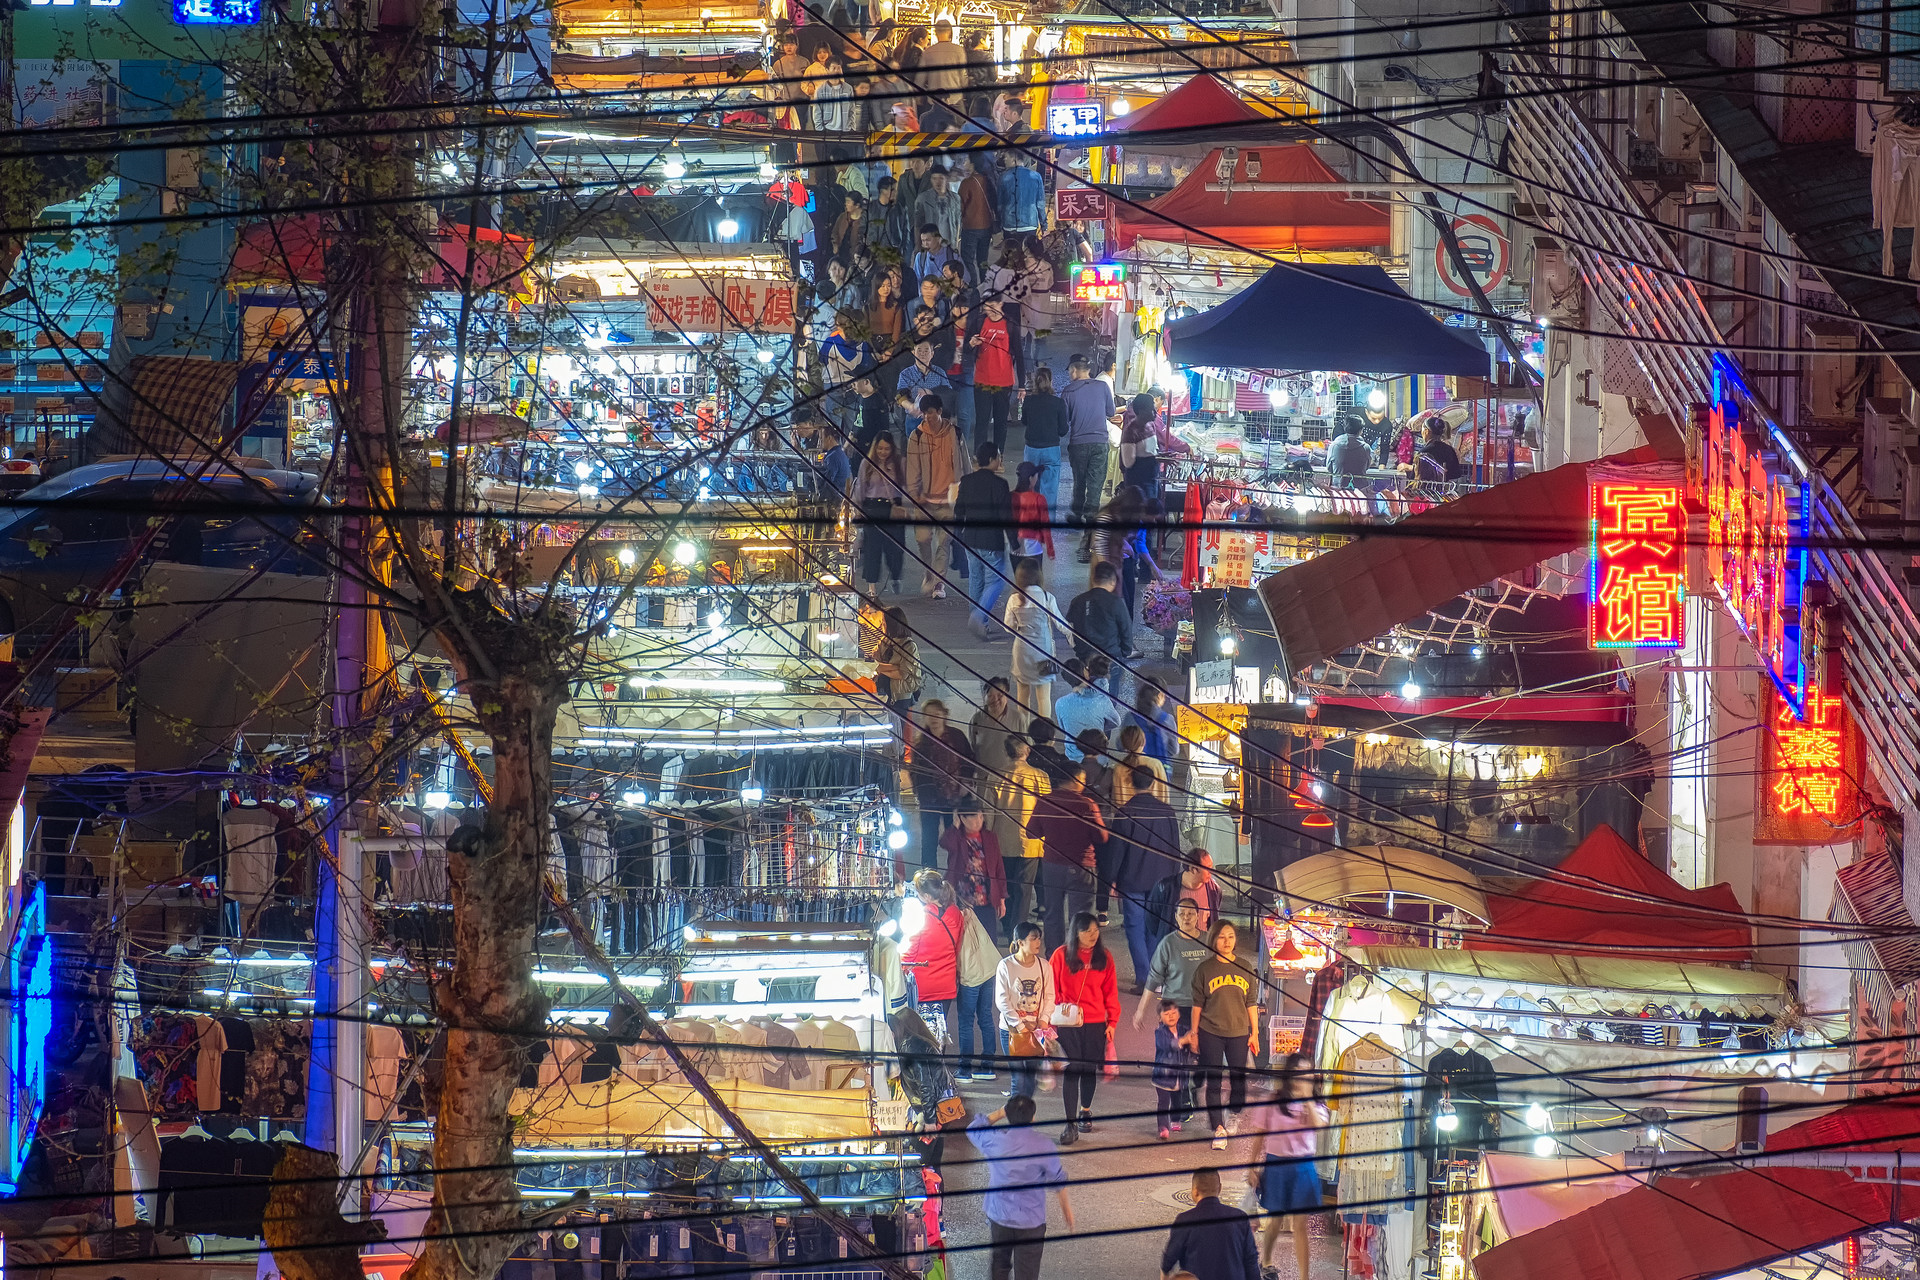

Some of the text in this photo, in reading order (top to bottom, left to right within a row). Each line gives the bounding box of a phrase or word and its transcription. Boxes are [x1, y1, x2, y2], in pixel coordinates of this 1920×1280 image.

[1060, 194, 1105, 216] 采耳
[1081, 269, 1113, 285] 美甲
[650, 295, 718, 324] 游戏手柄
[726, 285, 795, 327] 贴膜
[1599, 486, 1678, 642] 宾馆
[1774, 684, 1842, 814] 汗蒸馆
